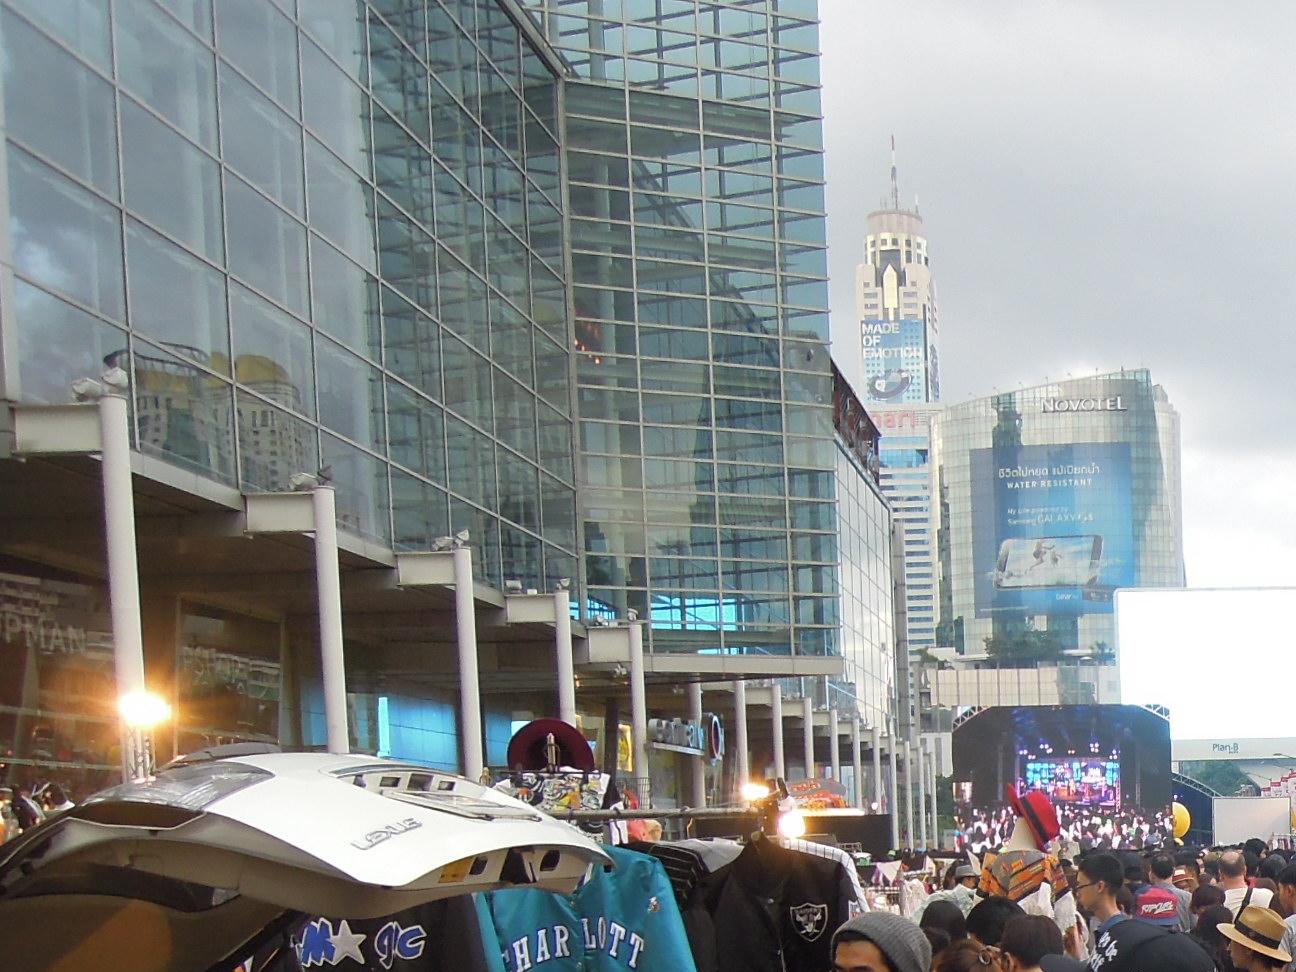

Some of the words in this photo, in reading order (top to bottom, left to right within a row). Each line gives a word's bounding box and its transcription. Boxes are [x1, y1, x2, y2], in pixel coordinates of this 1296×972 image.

[861, 323, 900, 335] MADE
[862, 335, 881, 347] OF
[1041, 396, 1128, 413] NOVOTEL
[1007, 480, 1037, 489] WATER
[1040, 478, 1092, 488] RESISTANT
